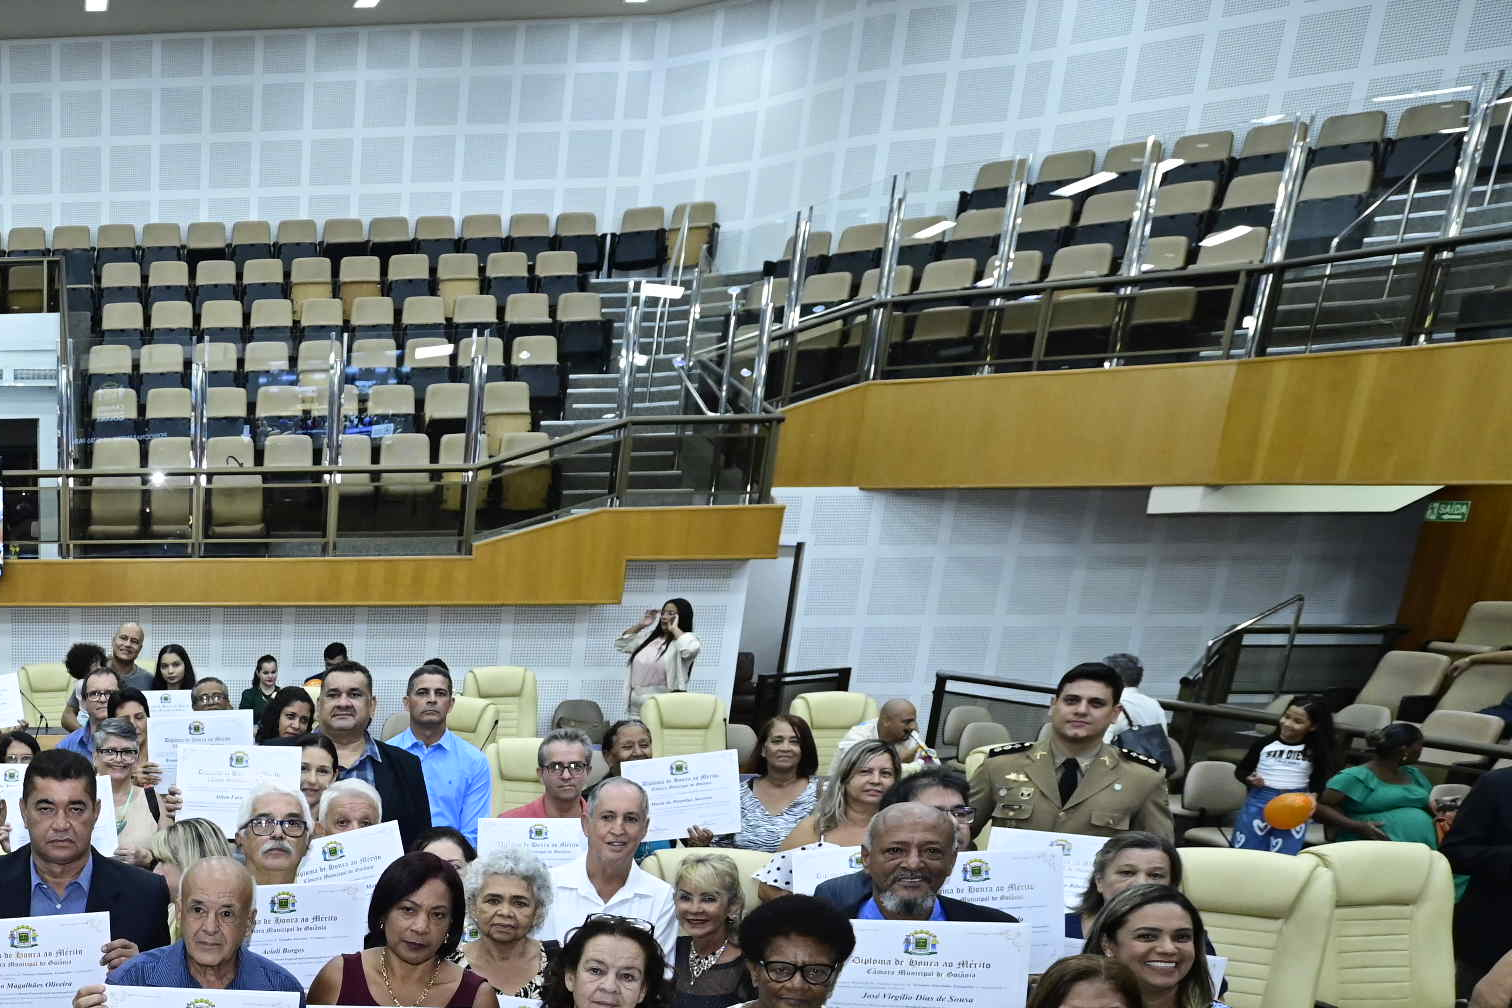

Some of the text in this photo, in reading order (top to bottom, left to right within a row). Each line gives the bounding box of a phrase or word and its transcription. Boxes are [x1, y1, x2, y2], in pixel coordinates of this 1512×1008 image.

[1440, 503, 1467, 513] SAÍDA
[852, 956, 891, 966] Diploma
[909, 959, 939, 967] Honra
[957, 960, 991, 969] Mérito
[883, 993, 912, 1002] Virgílio
